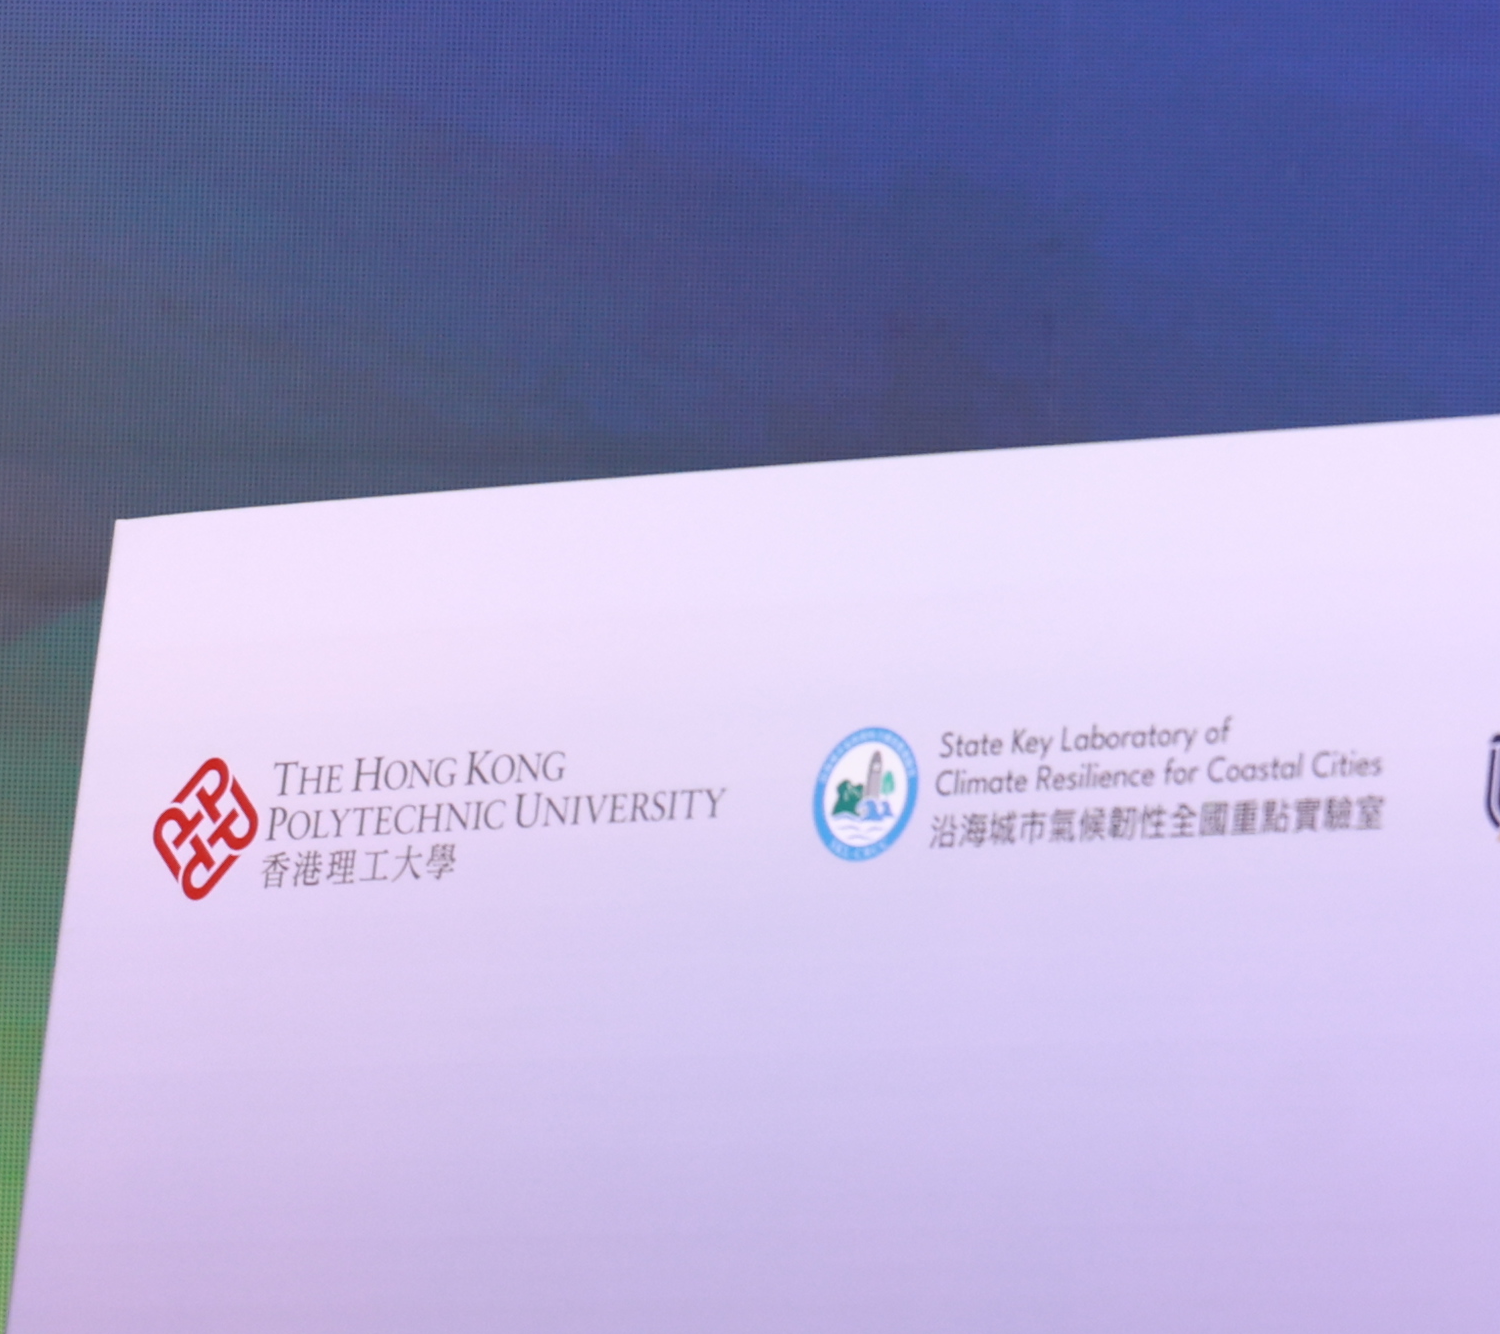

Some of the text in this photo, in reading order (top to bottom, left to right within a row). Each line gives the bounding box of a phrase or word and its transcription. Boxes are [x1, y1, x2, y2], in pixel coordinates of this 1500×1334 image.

[939, 731, 1004, 760] State
[1010, 729, 1053, 760] Key
[1061, 722, 1198, 753] Laboratory
[1205, 716, 1234, 747] of
[273, 750, 566, 797] THE HONG KONG
[935, 750, 1384, 798] Climate Resilience for Coastal Cities
[265, 787, 729, 843] POLYTECHNIC UNIVERSITY
[261, 843, 456, 890] 香港理工大學
